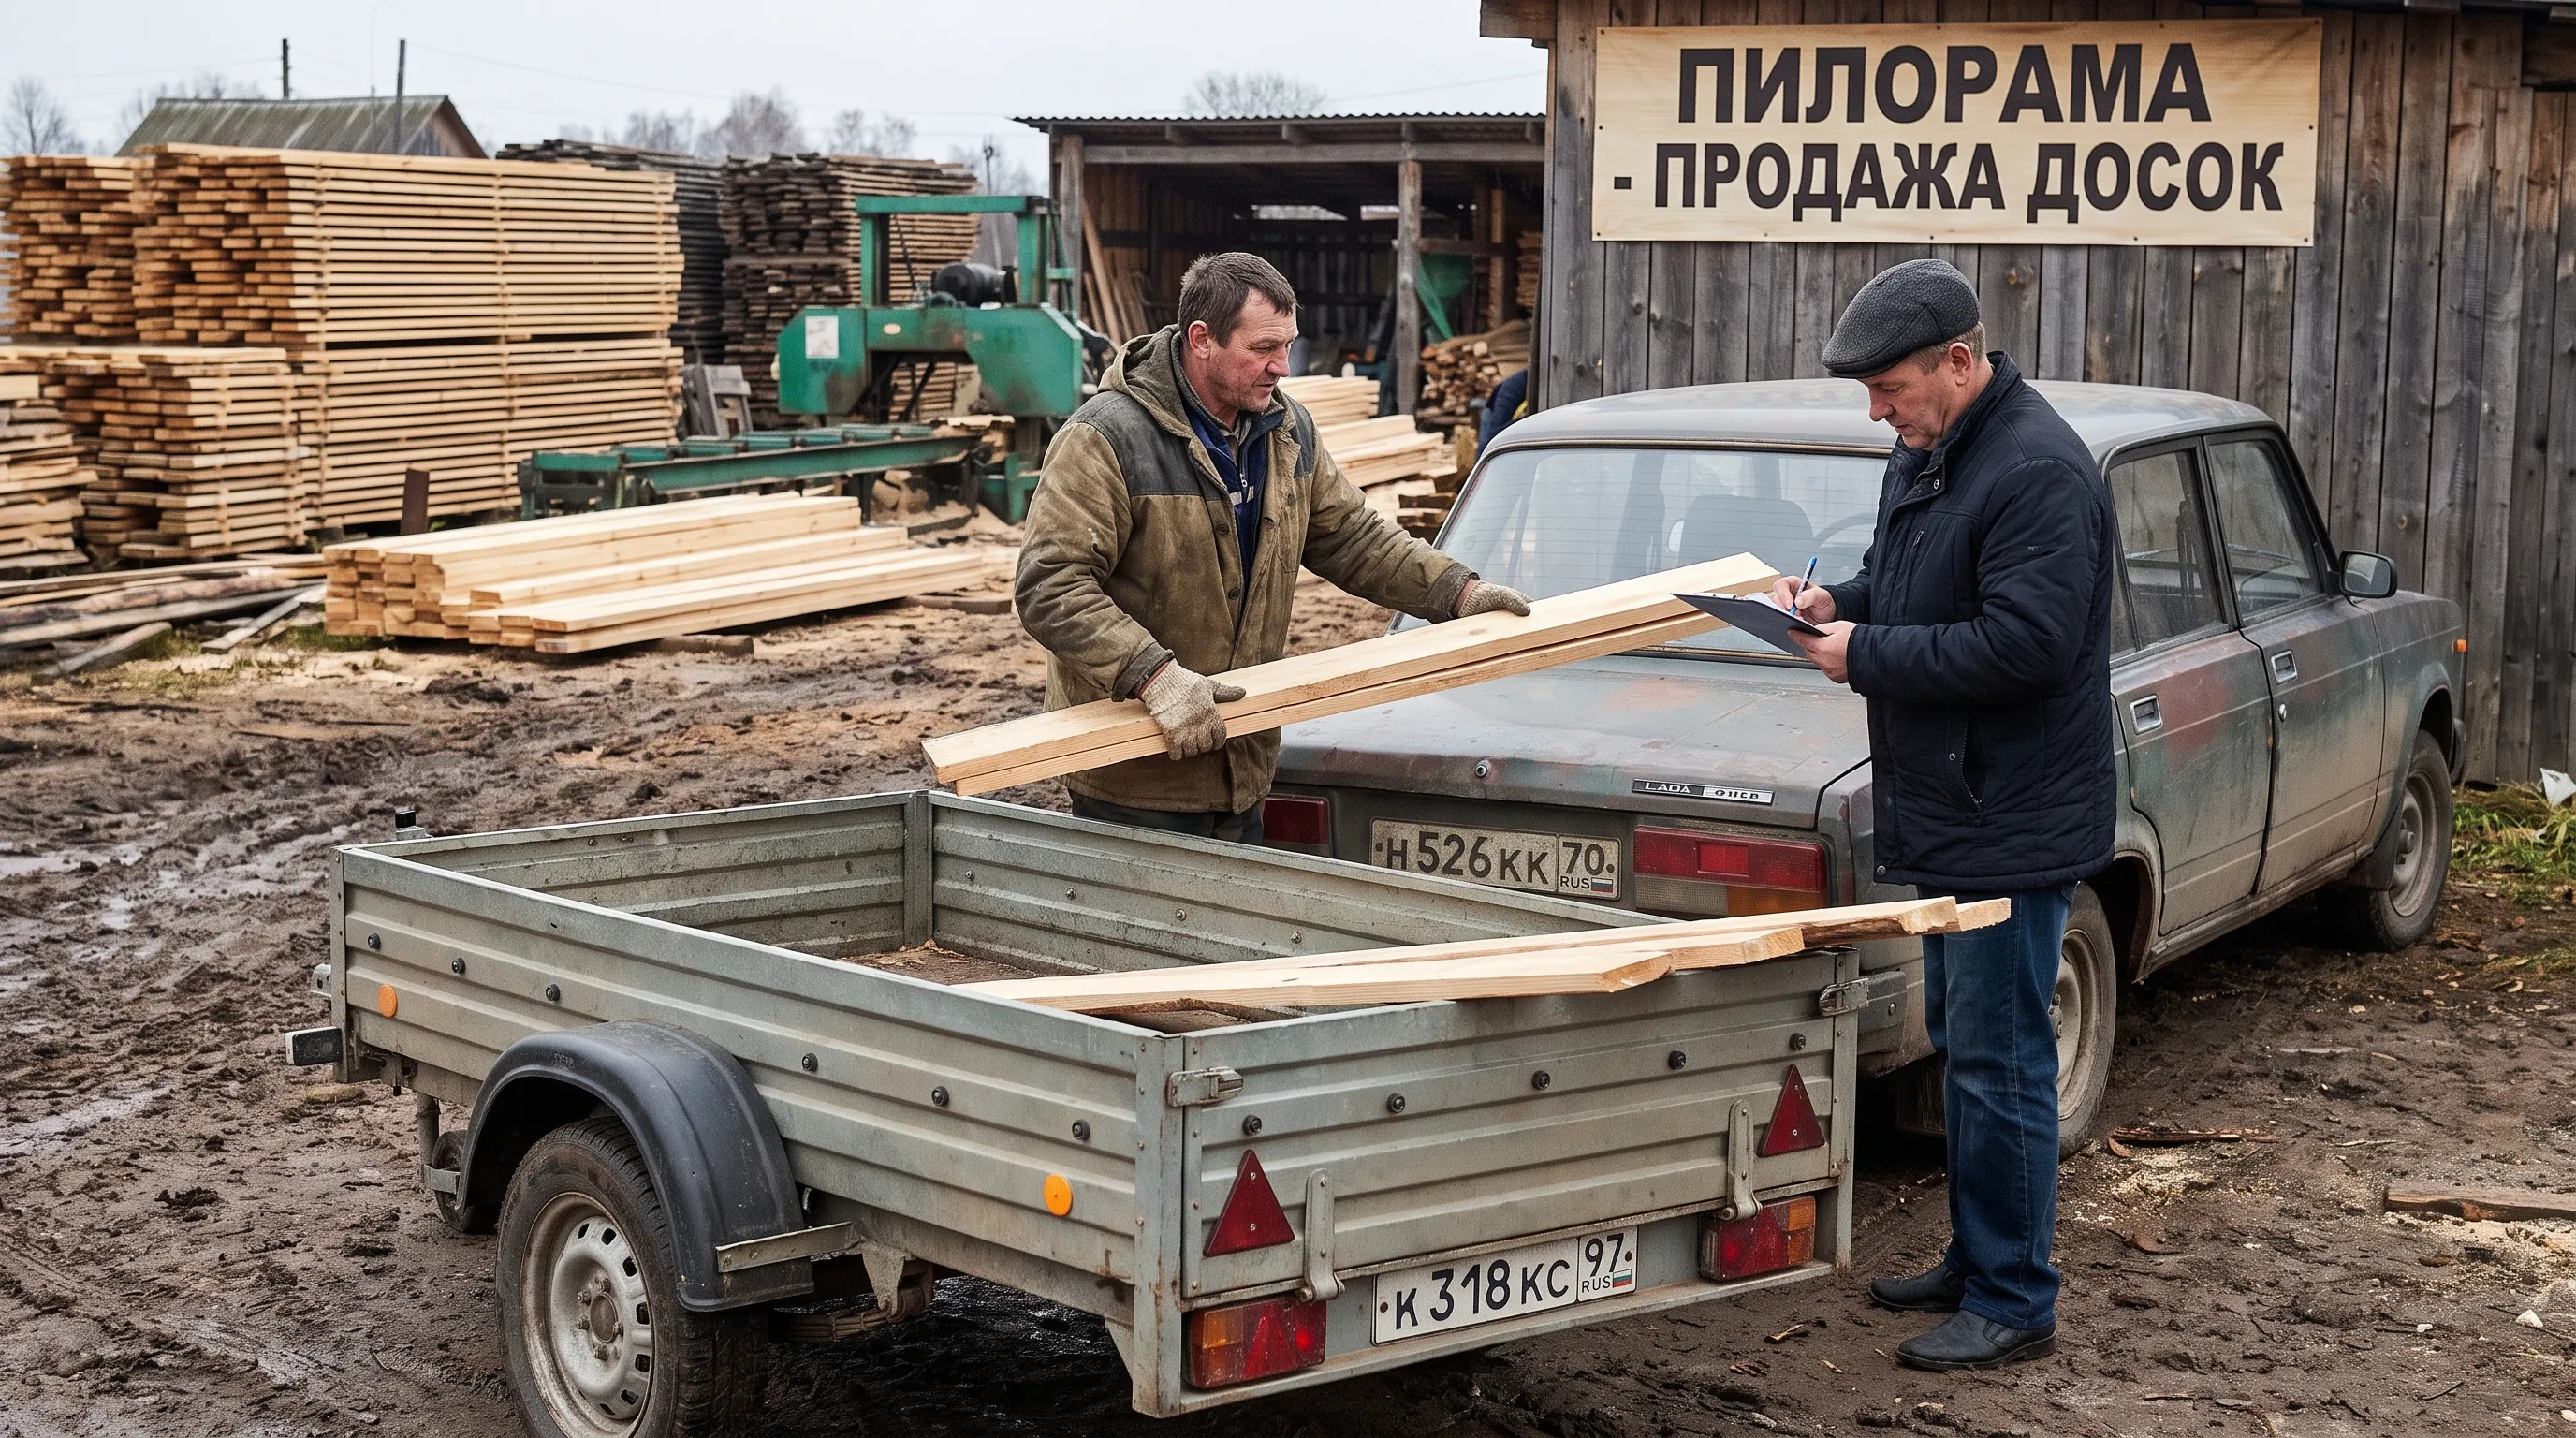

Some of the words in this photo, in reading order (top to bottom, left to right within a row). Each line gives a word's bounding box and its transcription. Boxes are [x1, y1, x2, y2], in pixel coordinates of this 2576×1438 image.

[1677, 42, 2212, 124] ПИЛОРАМА
[1654, 142, 2005, 222] ПРОДАЖА
[2027, 141, 2284, 224] ДОСОК
[1645, 782, 1691, 794] LADA
[1562, 842, 1605, 875] 70
[1560, 875, 1590, 889] RUS
[1584, 1232, 1625, 1278] 97
[1581, 1275, 1611, 1294] RUS
